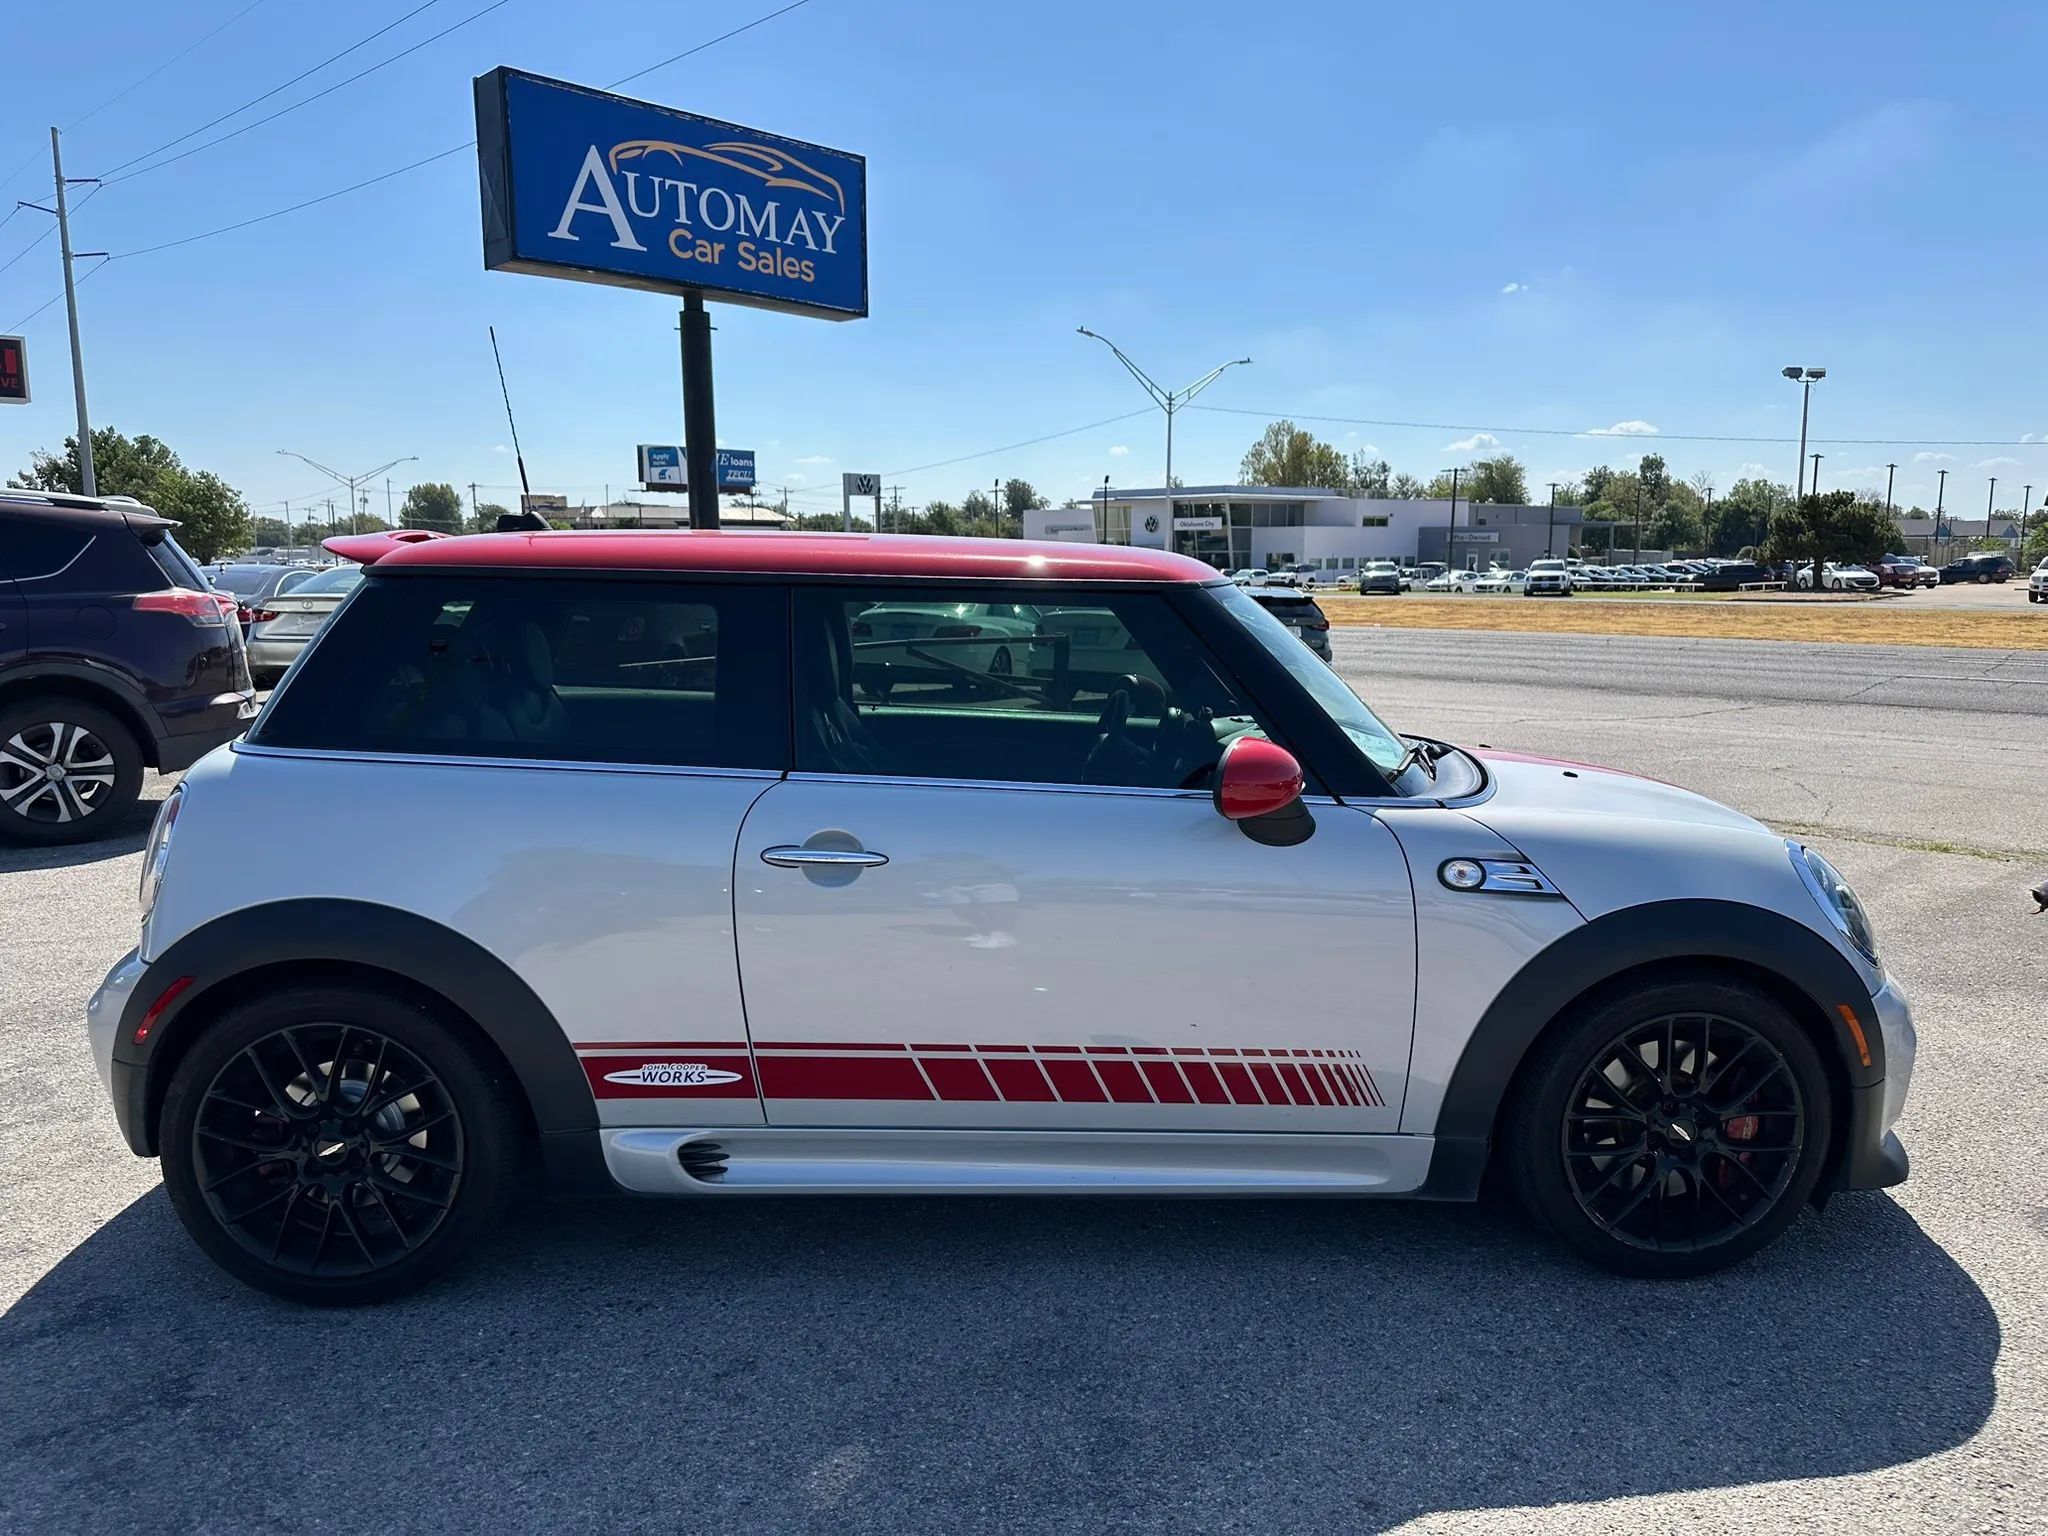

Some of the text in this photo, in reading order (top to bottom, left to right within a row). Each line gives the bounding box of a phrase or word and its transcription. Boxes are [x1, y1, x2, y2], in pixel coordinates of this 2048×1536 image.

[547, 144, 846, 254] AUTOMAY
[668, 228, 815, 283] Car Sales
[730, 456, 754, 467] loans
[1205, 520, 1215, 528] City
[641, 1070, 707, 1083] WORKS
